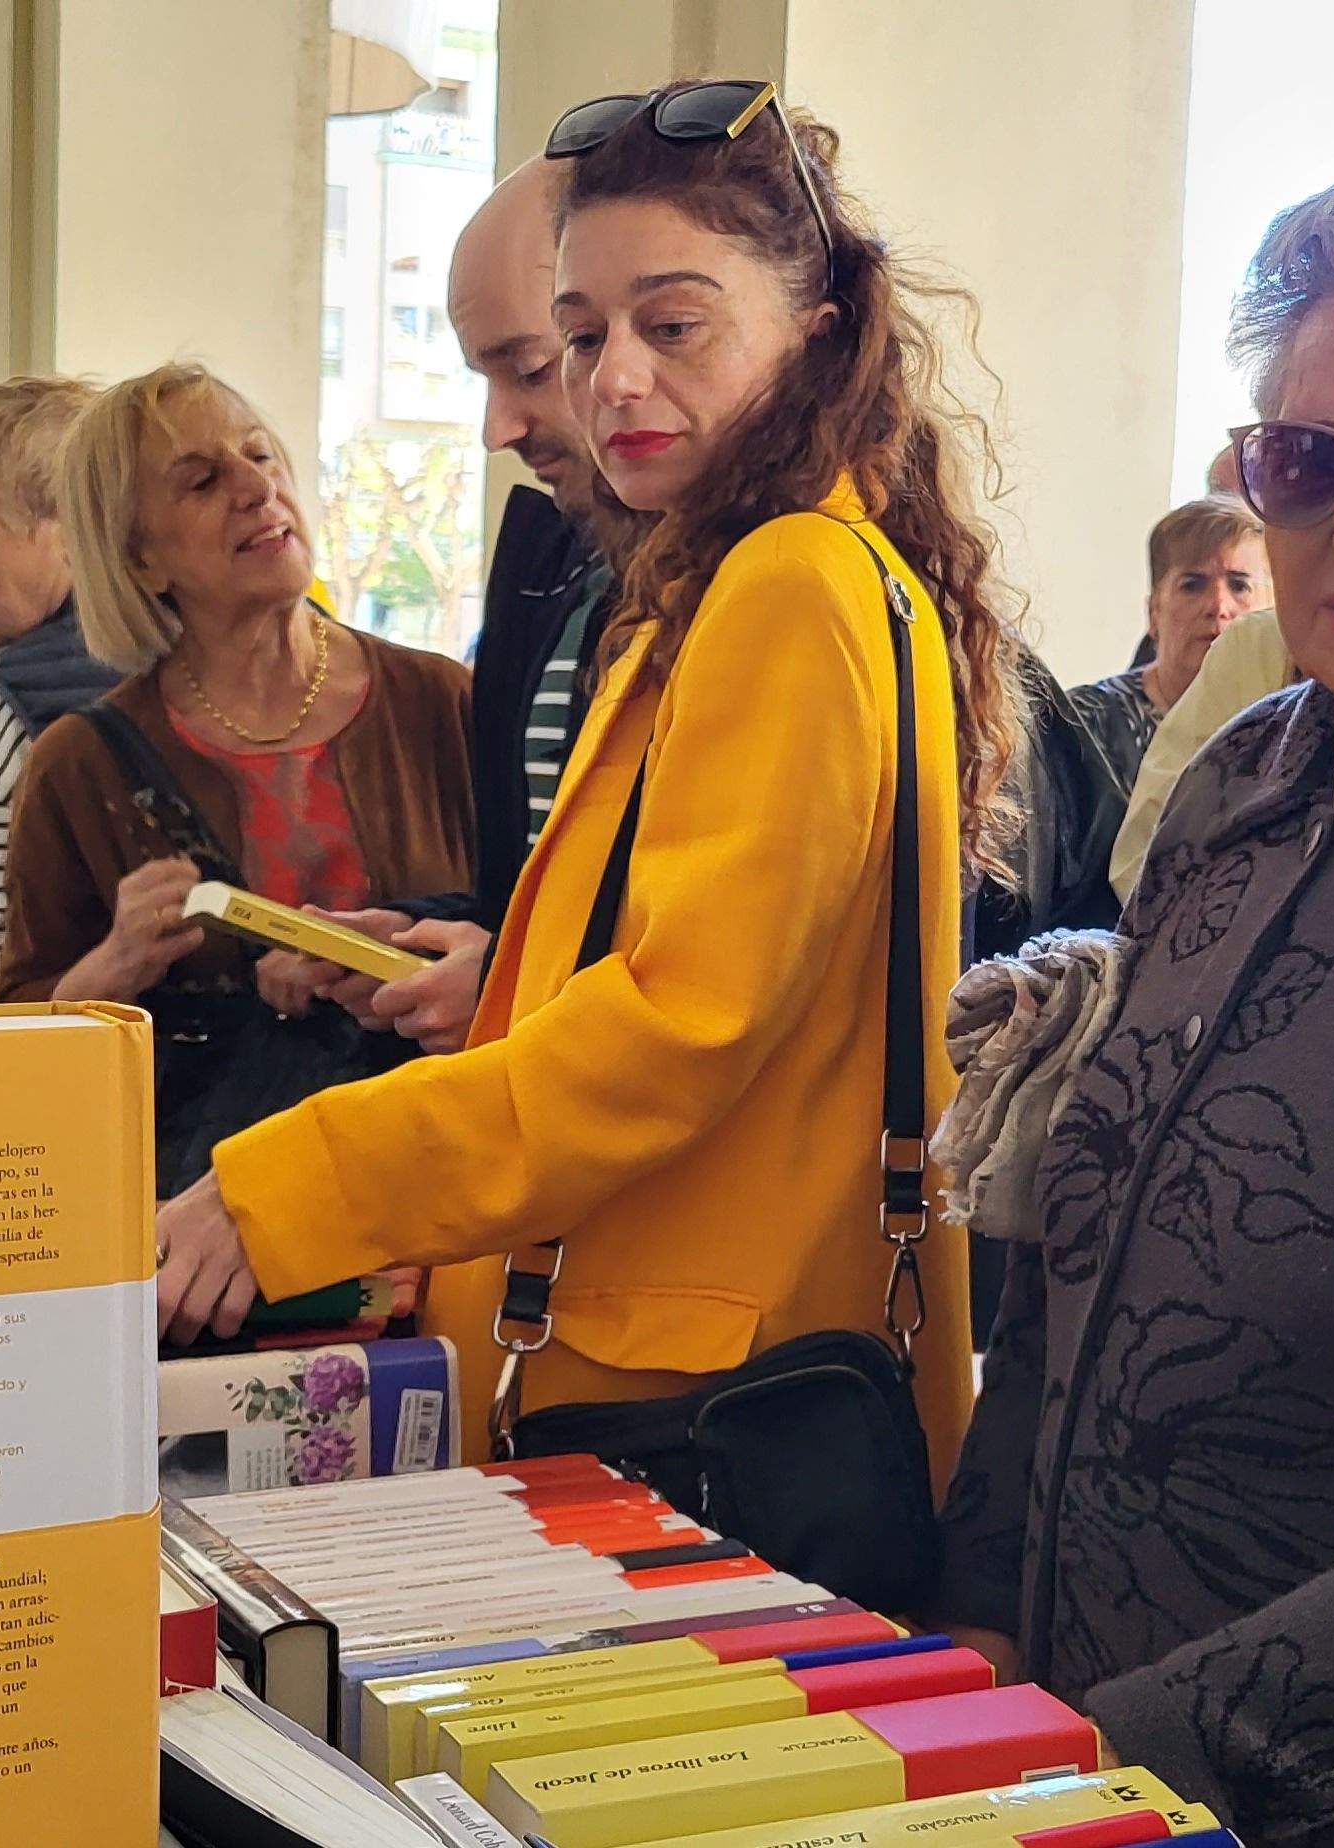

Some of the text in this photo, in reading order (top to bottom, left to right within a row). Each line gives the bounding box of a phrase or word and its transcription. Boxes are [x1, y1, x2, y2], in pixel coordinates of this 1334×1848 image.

[7, 1594, 48, 1609] arras-
[467, 1720, 518, 1734] Libre
[534, 1734, 868, 1791] TOKARCZUK Los libros de Jacob
[838, 1831, 868, 1844] La
